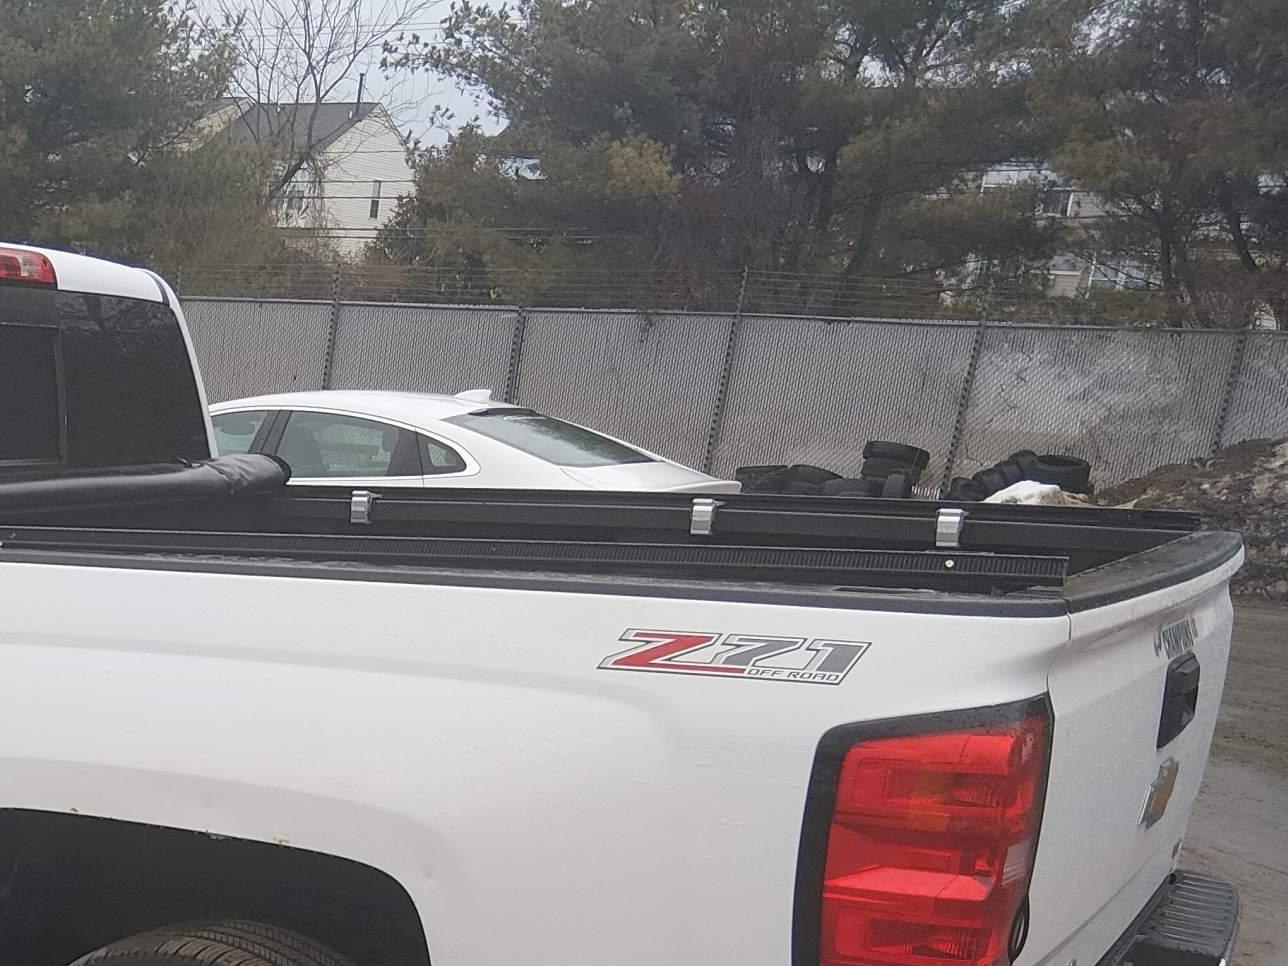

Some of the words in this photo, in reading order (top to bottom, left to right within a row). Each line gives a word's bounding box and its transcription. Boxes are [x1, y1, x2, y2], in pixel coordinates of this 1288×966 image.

[598, 629, 870, 681] Z71
[747, 668, 784, 677] OFF
[787, 671, 840, 681] ROAD
